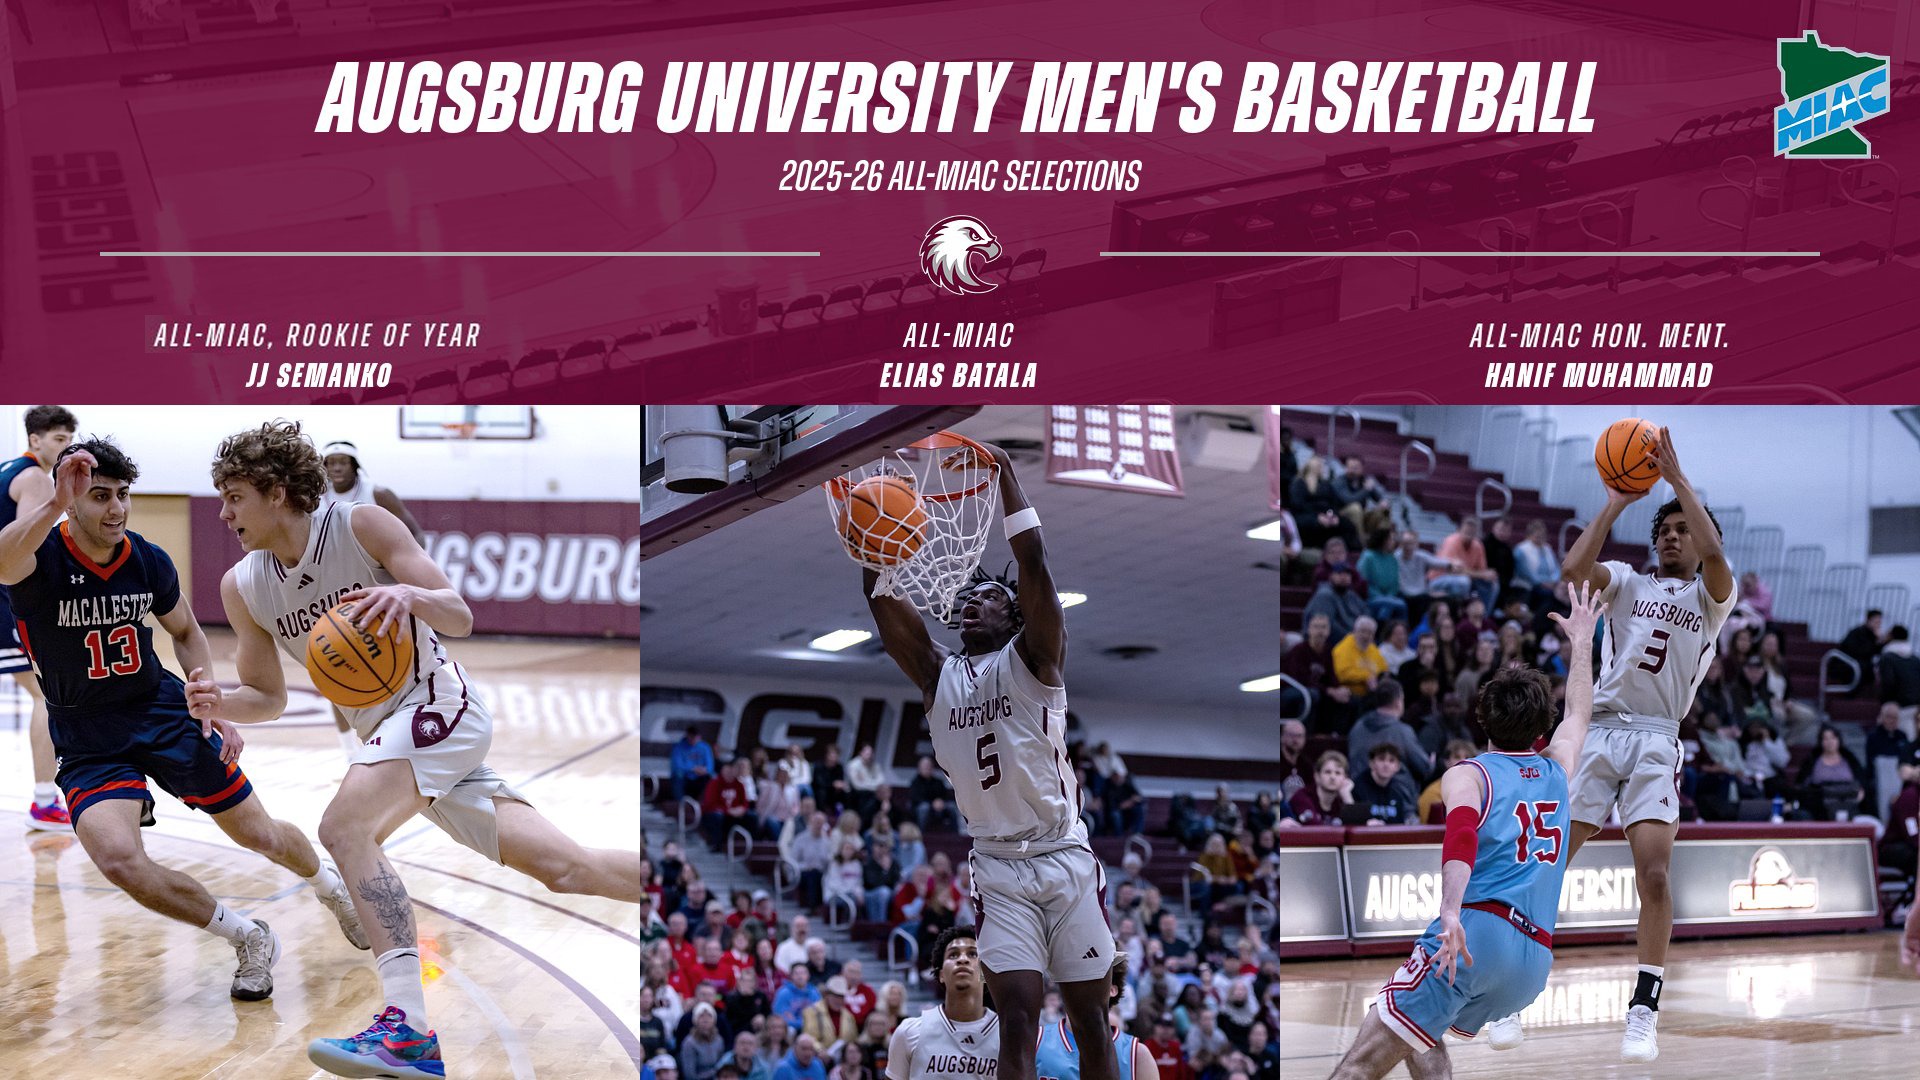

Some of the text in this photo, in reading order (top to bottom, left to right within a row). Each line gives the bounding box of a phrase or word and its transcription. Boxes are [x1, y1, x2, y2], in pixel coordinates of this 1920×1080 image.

[1630, 599, 1703, 634] AUGSBURG
[84, 623, 143, 680] 13
[1636, 627, 1672, 676] 3
[976, 731, 1003, 792] 5
[1512, 800, 1563, 866] 15
[925, 1055, 998, 1078] AUGSBUR
